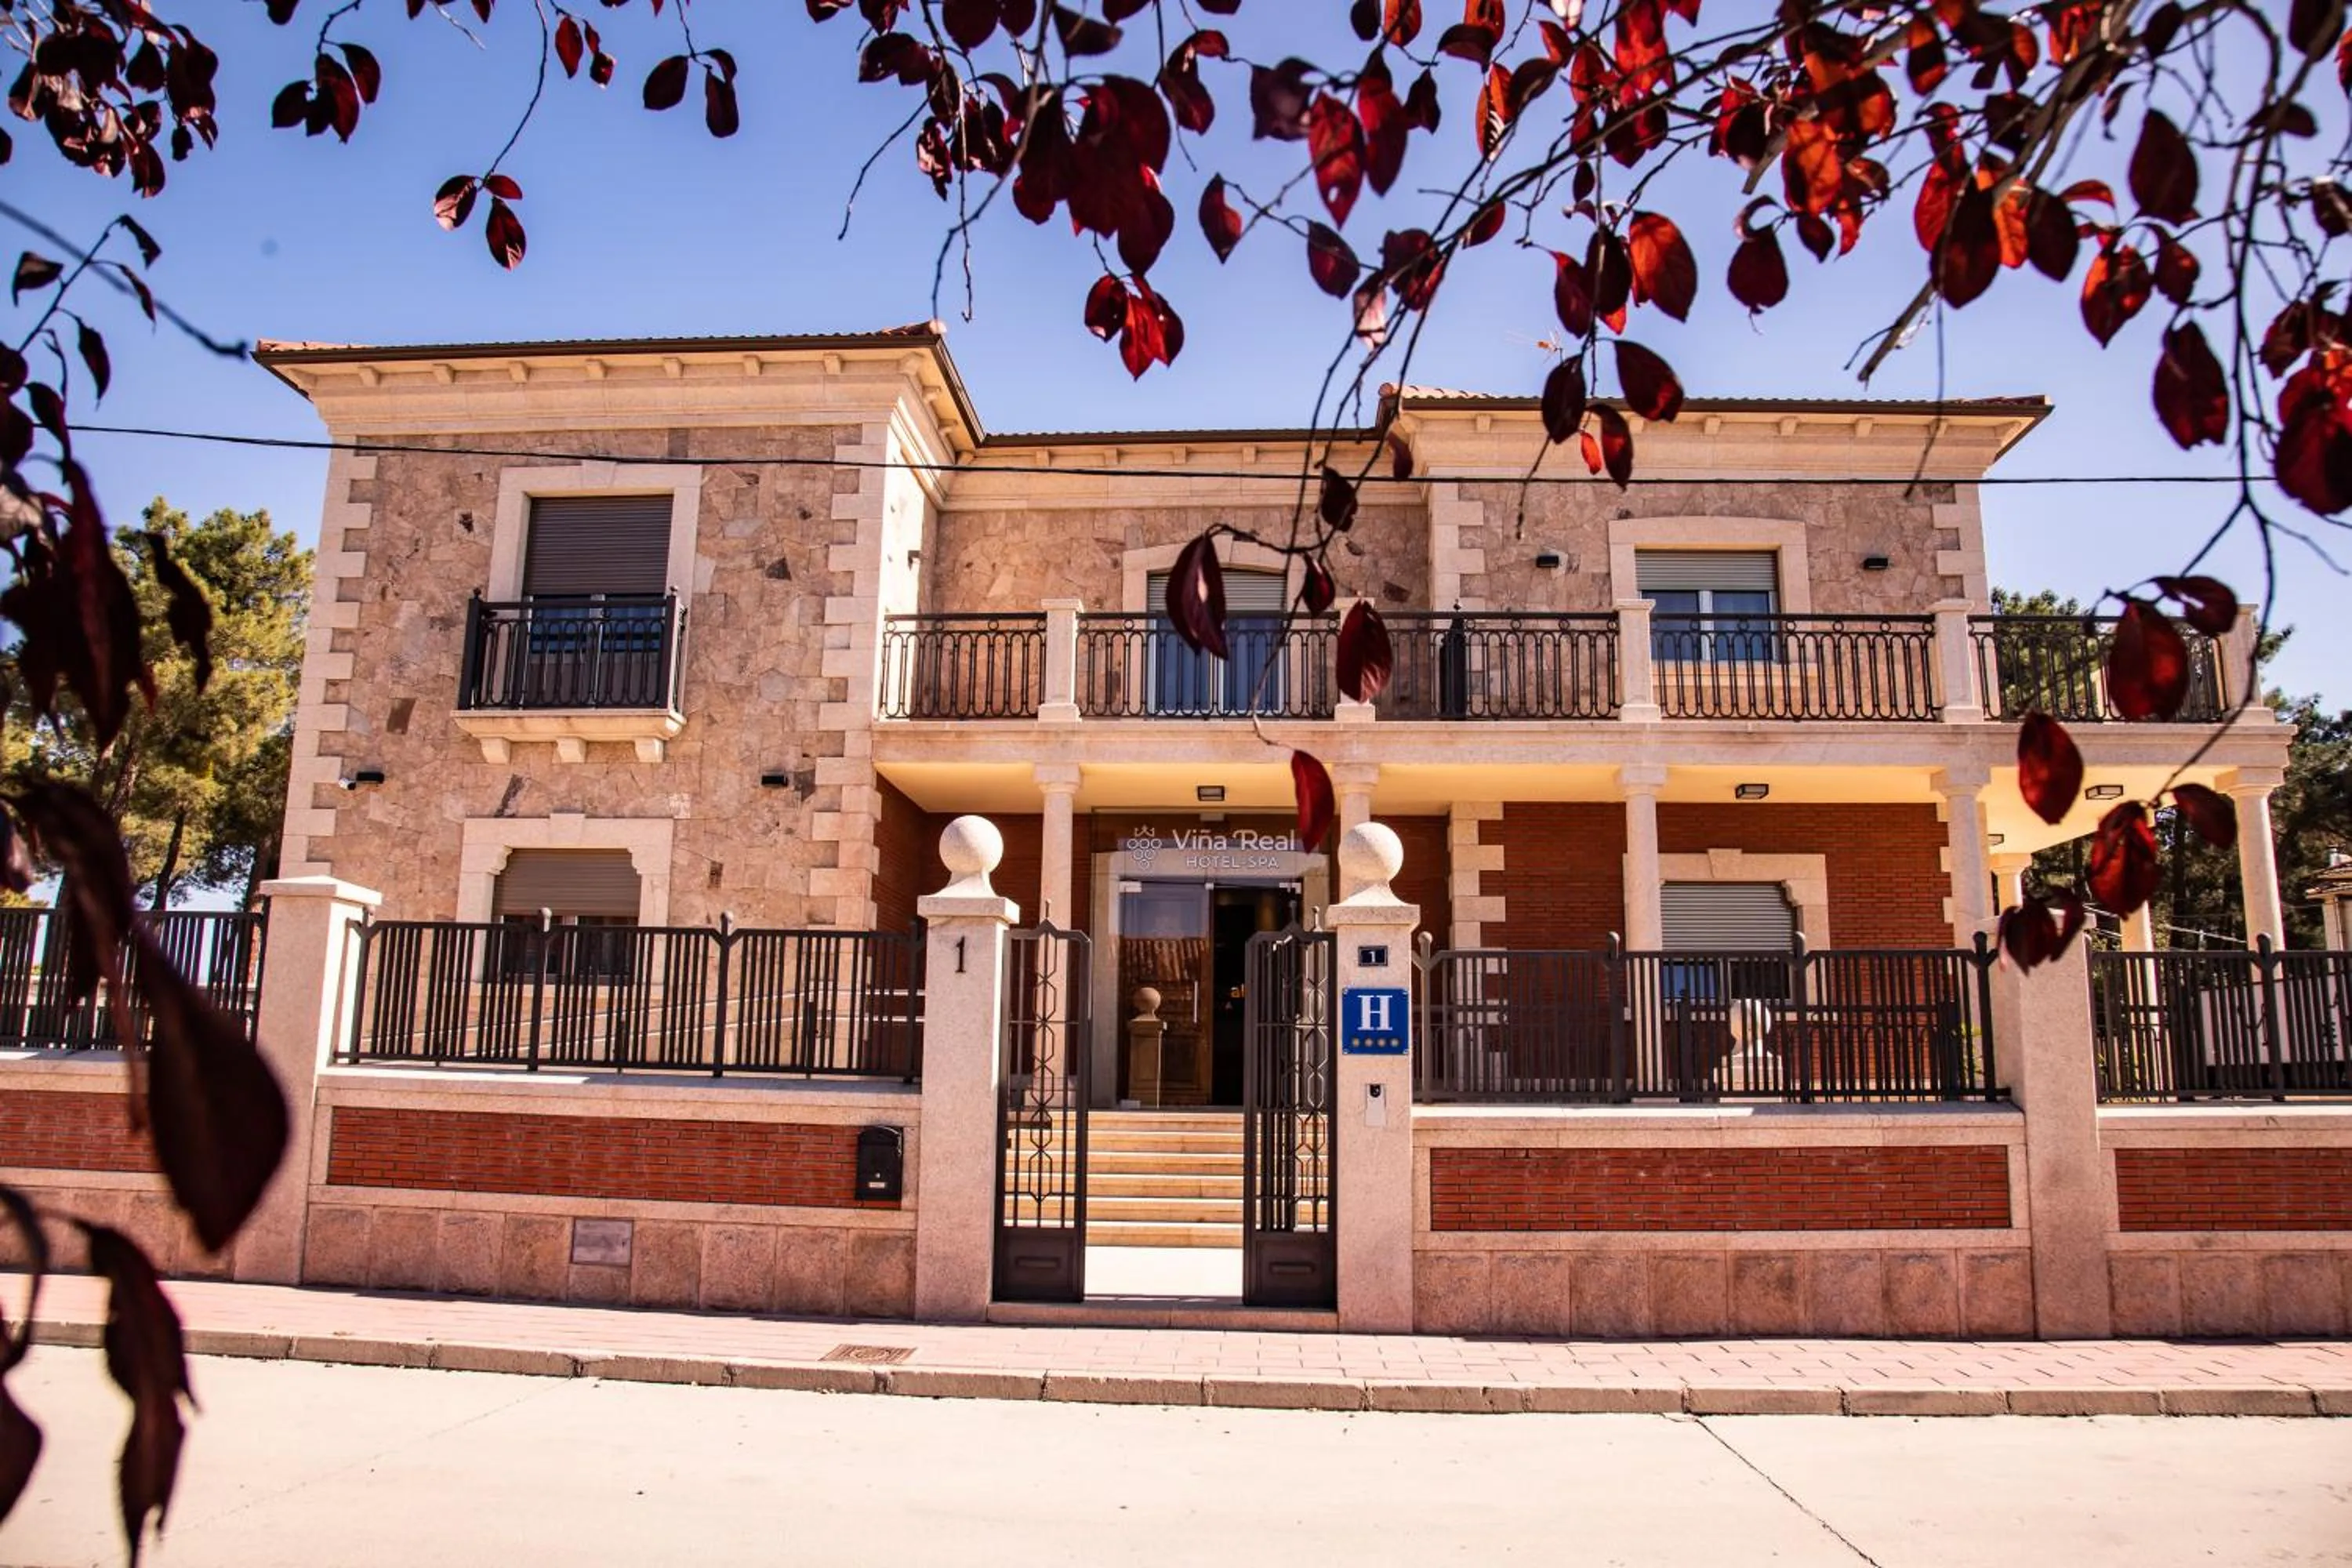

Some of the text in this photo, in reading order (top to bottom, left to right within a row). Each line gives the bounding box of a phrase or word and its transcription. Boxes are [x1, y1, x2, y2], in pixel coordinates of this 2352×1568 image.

[1172, 829, 1295, 851] Viña Real
[955, 935, 966, 974] 1
[1368, 951, 1376, 963] 1
[1358, 995, 1392, 1030] H
